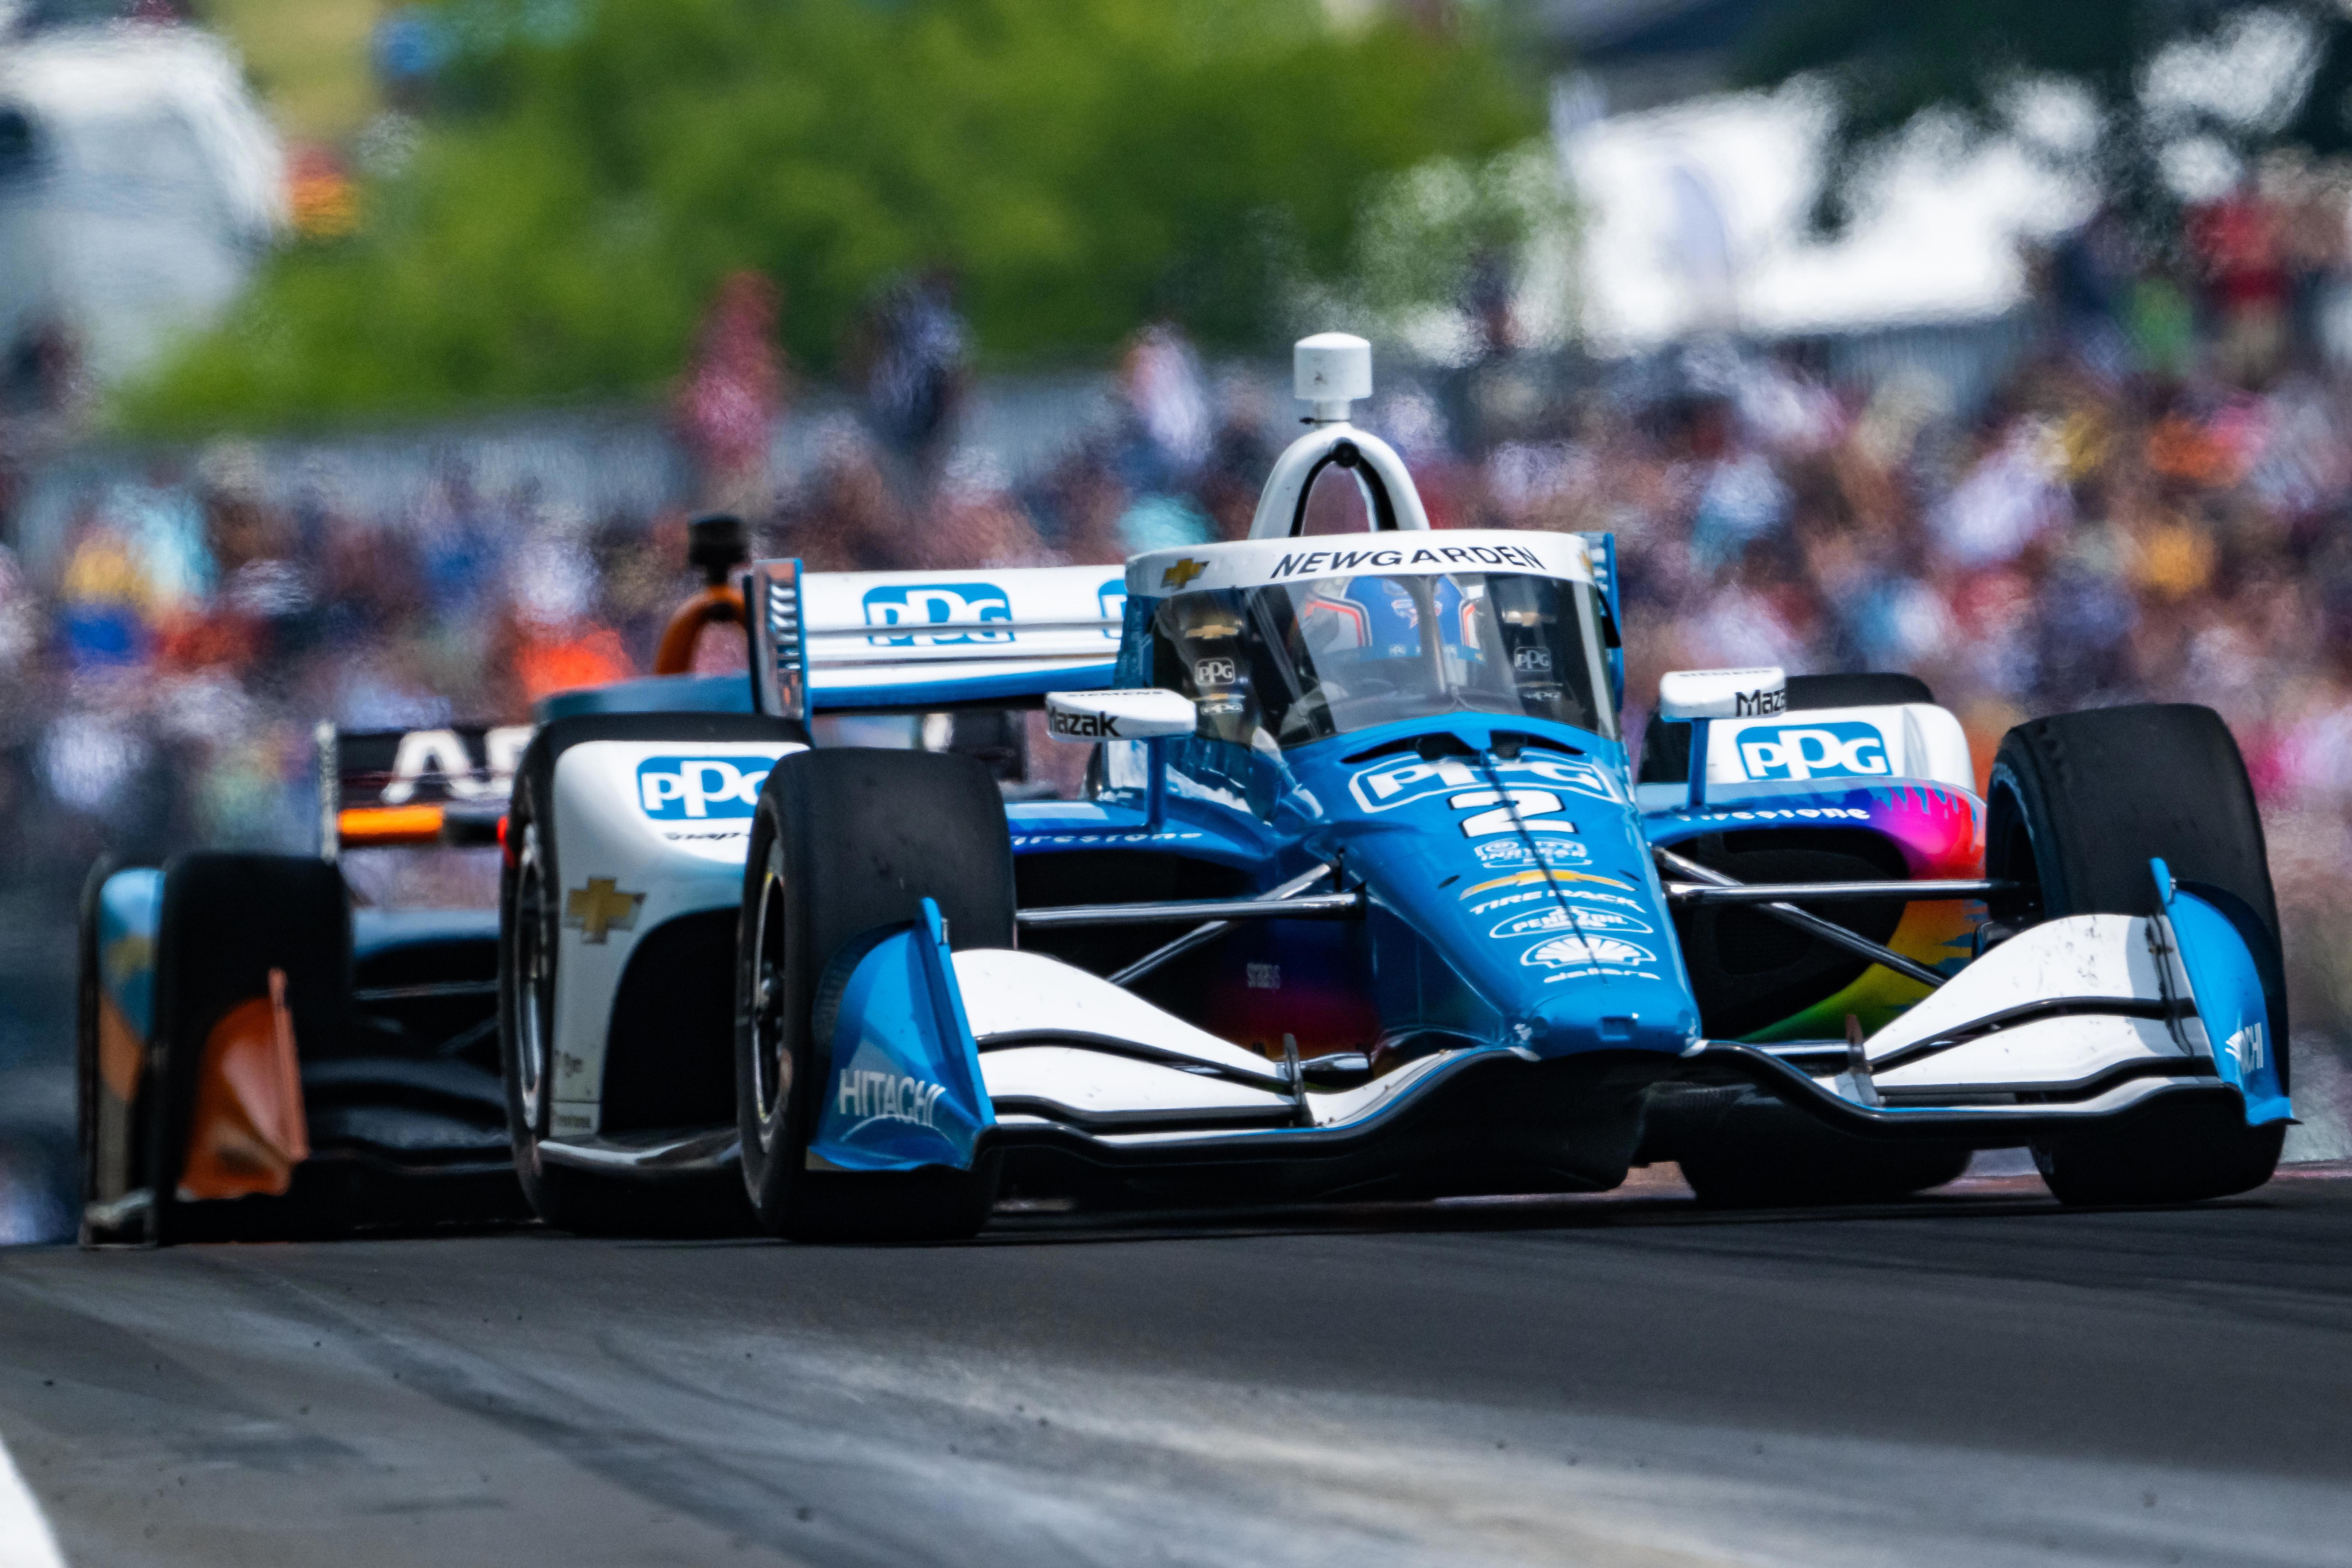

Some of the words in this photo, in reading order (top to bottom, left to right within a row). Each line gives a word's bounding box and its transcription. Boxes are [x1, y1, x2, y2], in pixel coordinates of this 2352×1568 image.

[1270, 546, 1547, 579] NEWGARDEN
[868, 590, 1009, 645] PPG
[1741, 729, 1889, 779] PPG
[1446, 790, 1579, 839] 2
[1469, 891, 1542, 915] TIRE
[839, 1068, 946, 1126] HITACHI
